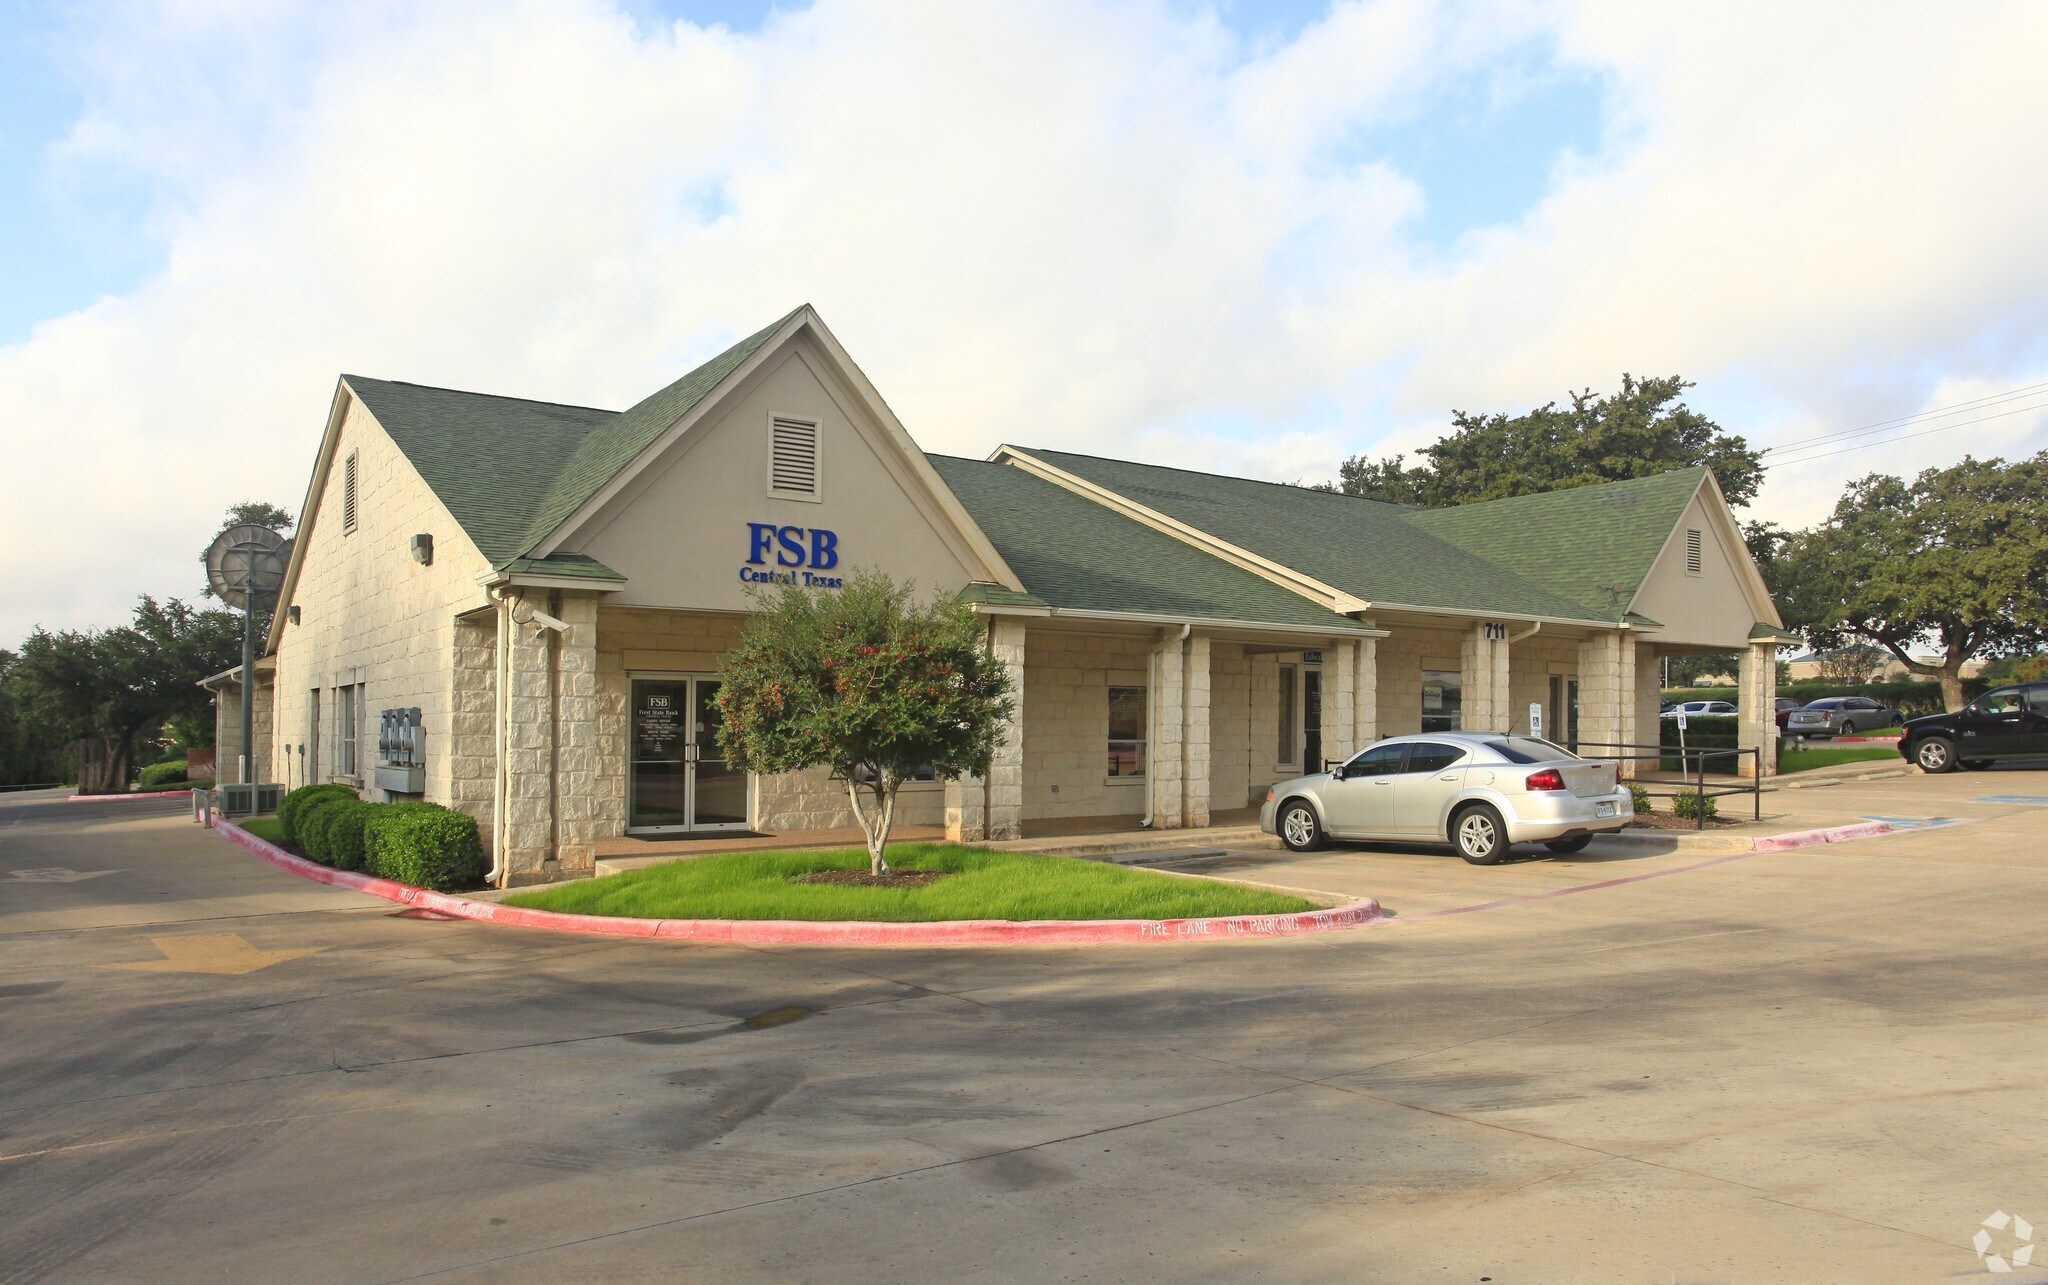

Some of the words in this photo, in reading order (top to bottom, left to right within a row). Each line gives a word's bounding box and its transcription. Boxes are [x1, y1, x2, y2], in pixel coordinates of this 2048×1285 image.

[745, 522, 838, 569] FSB
[802, 571, 843, 588] Texas
[1485, 622, 1505, 639] 711
[650, 697, 668, 707] FSB
[1141, 922, 1170, 936] FIRE
[1178, 921, 1211, 935] LANE
[1227, 919, 1244, 933] NO
[1250, 917, 1300, 934] PARKING
[1313, 915, 1334, 929] TOW
